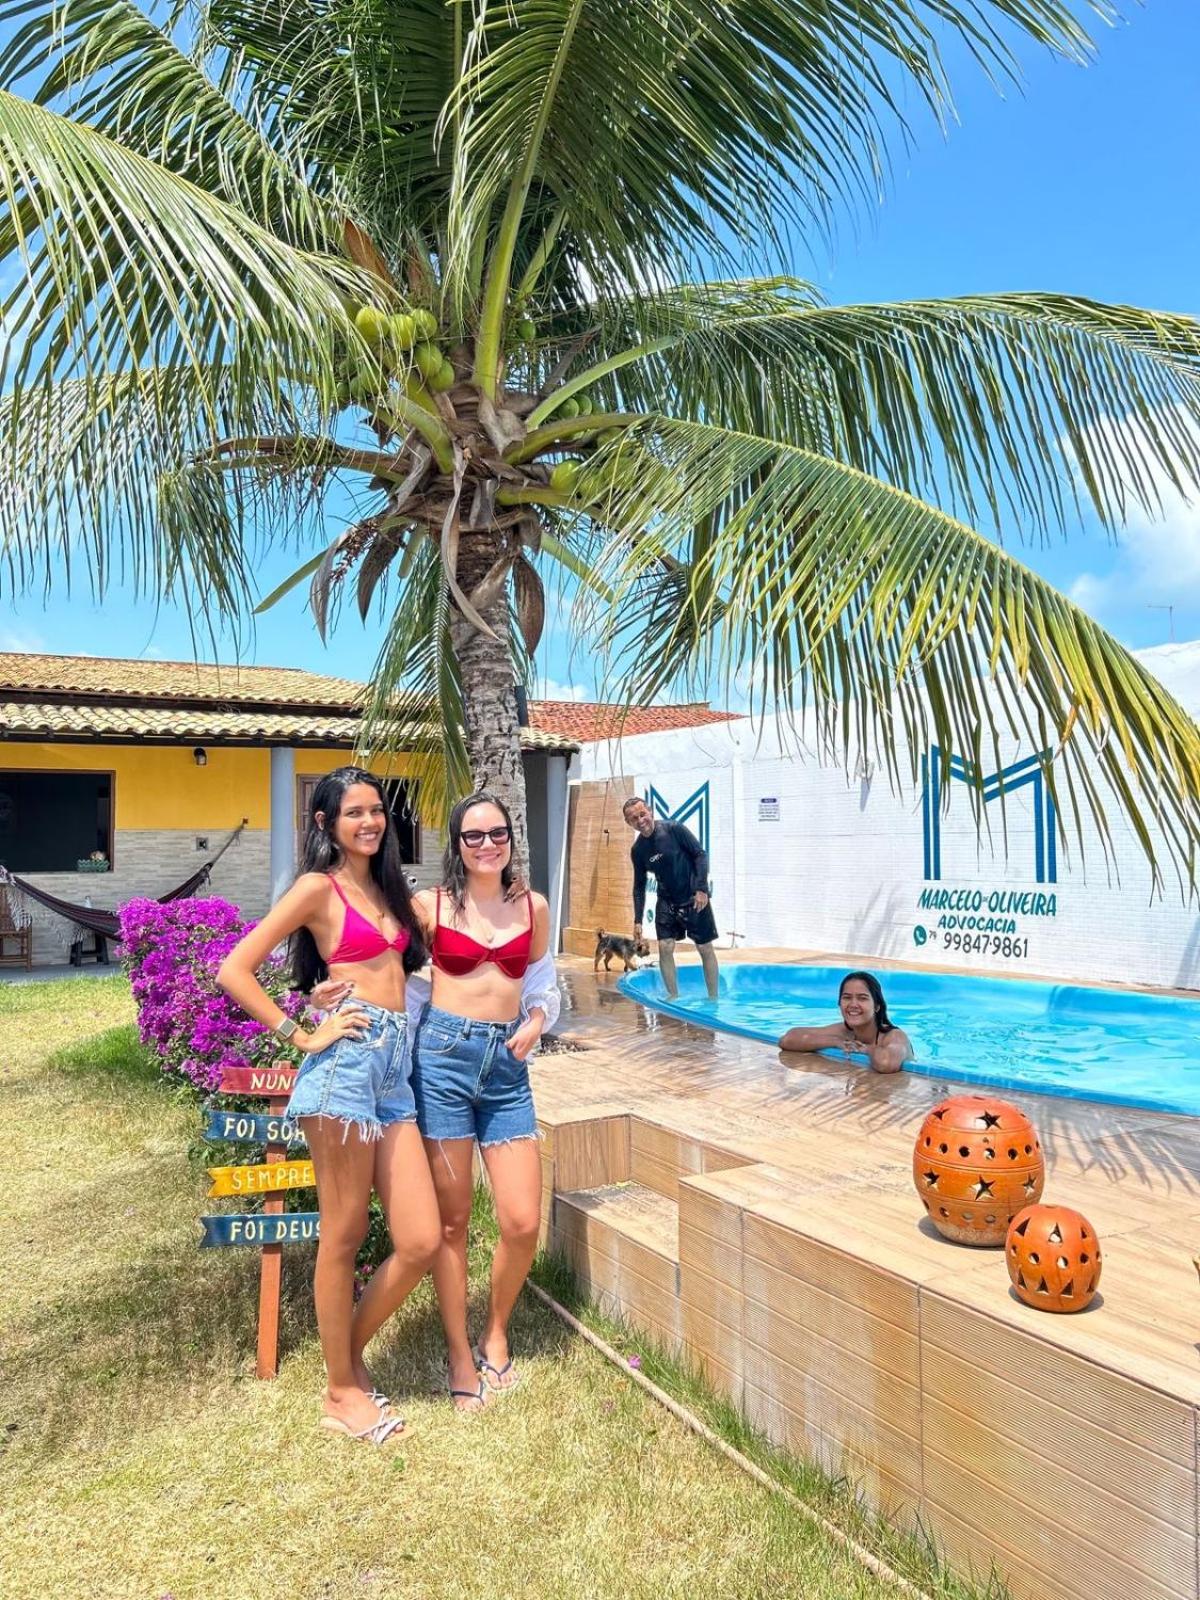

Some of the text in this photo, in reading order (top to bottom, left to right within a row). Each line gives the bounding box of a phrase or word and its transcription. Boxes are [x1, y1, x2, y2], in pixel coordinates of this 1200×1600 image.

[917, 888, 1057, 917] MARCELO OLIVEIRA
[937, 914, 1017, 934] ADVOCACIA
[223, 1117, 256, 1139] FOI
[231, 1166, 312, 1190] SEMPRE
[230, 1220, 265, 1242] FOI
